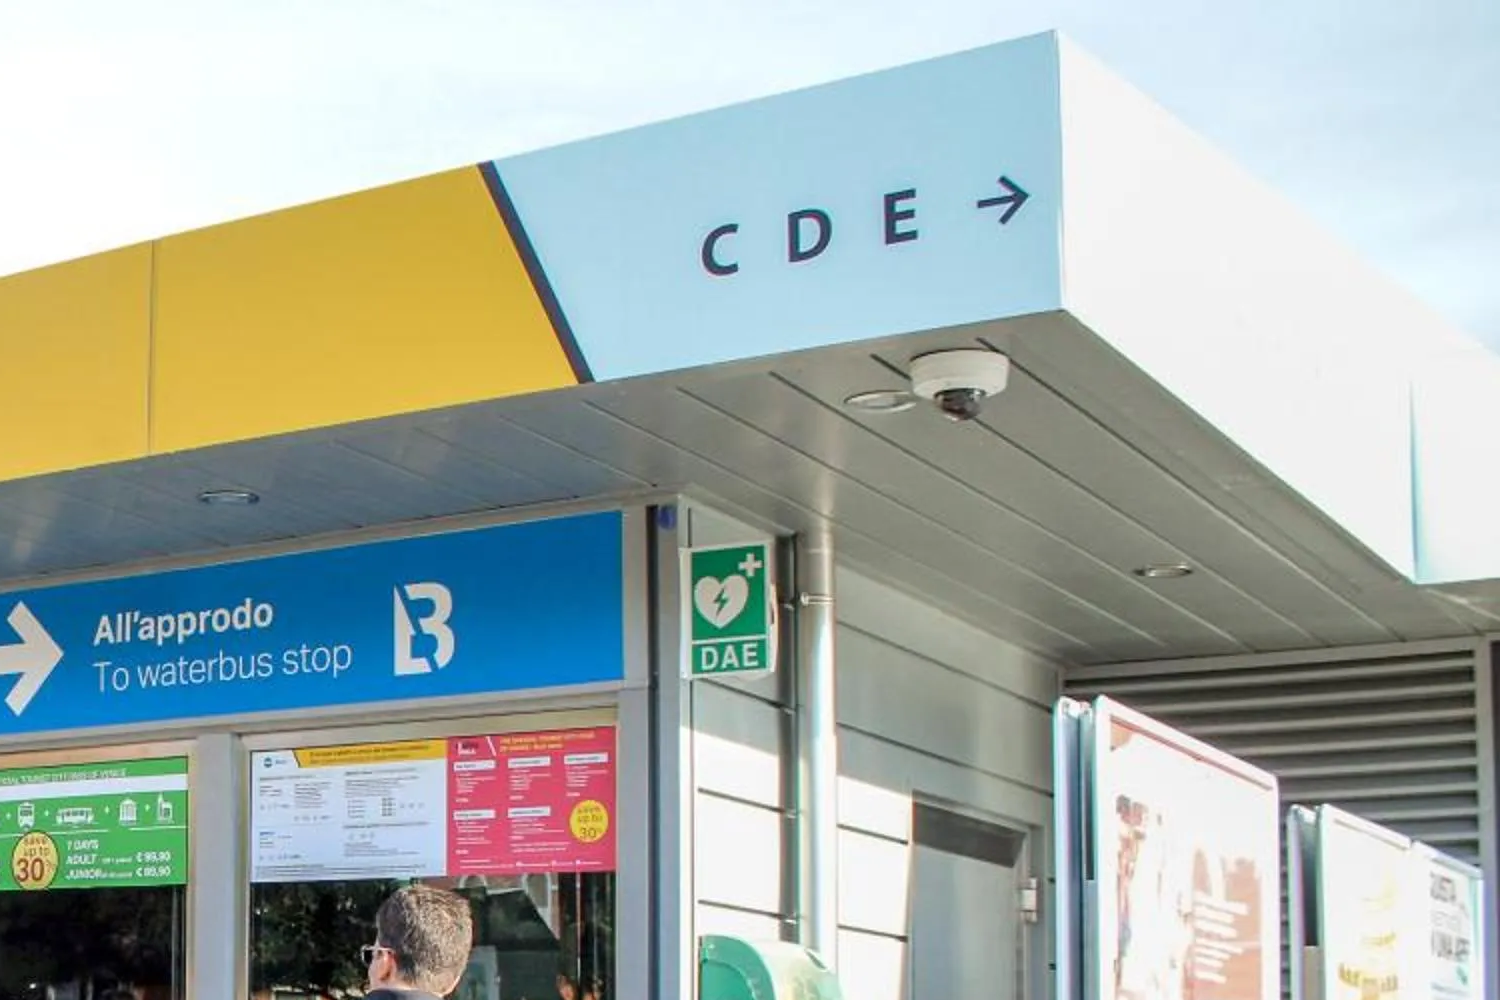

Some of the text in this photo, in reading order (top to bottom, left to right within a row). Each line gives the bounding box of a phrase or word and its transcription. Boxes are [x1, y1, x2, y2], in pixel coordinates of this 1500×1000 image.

[701, 188, 919, 277] C D E
[93, 597, 274, 646] All'approdo
[93, 641, 352, 693] To waterbus stop
[701, 642, 759, 671] DAE
